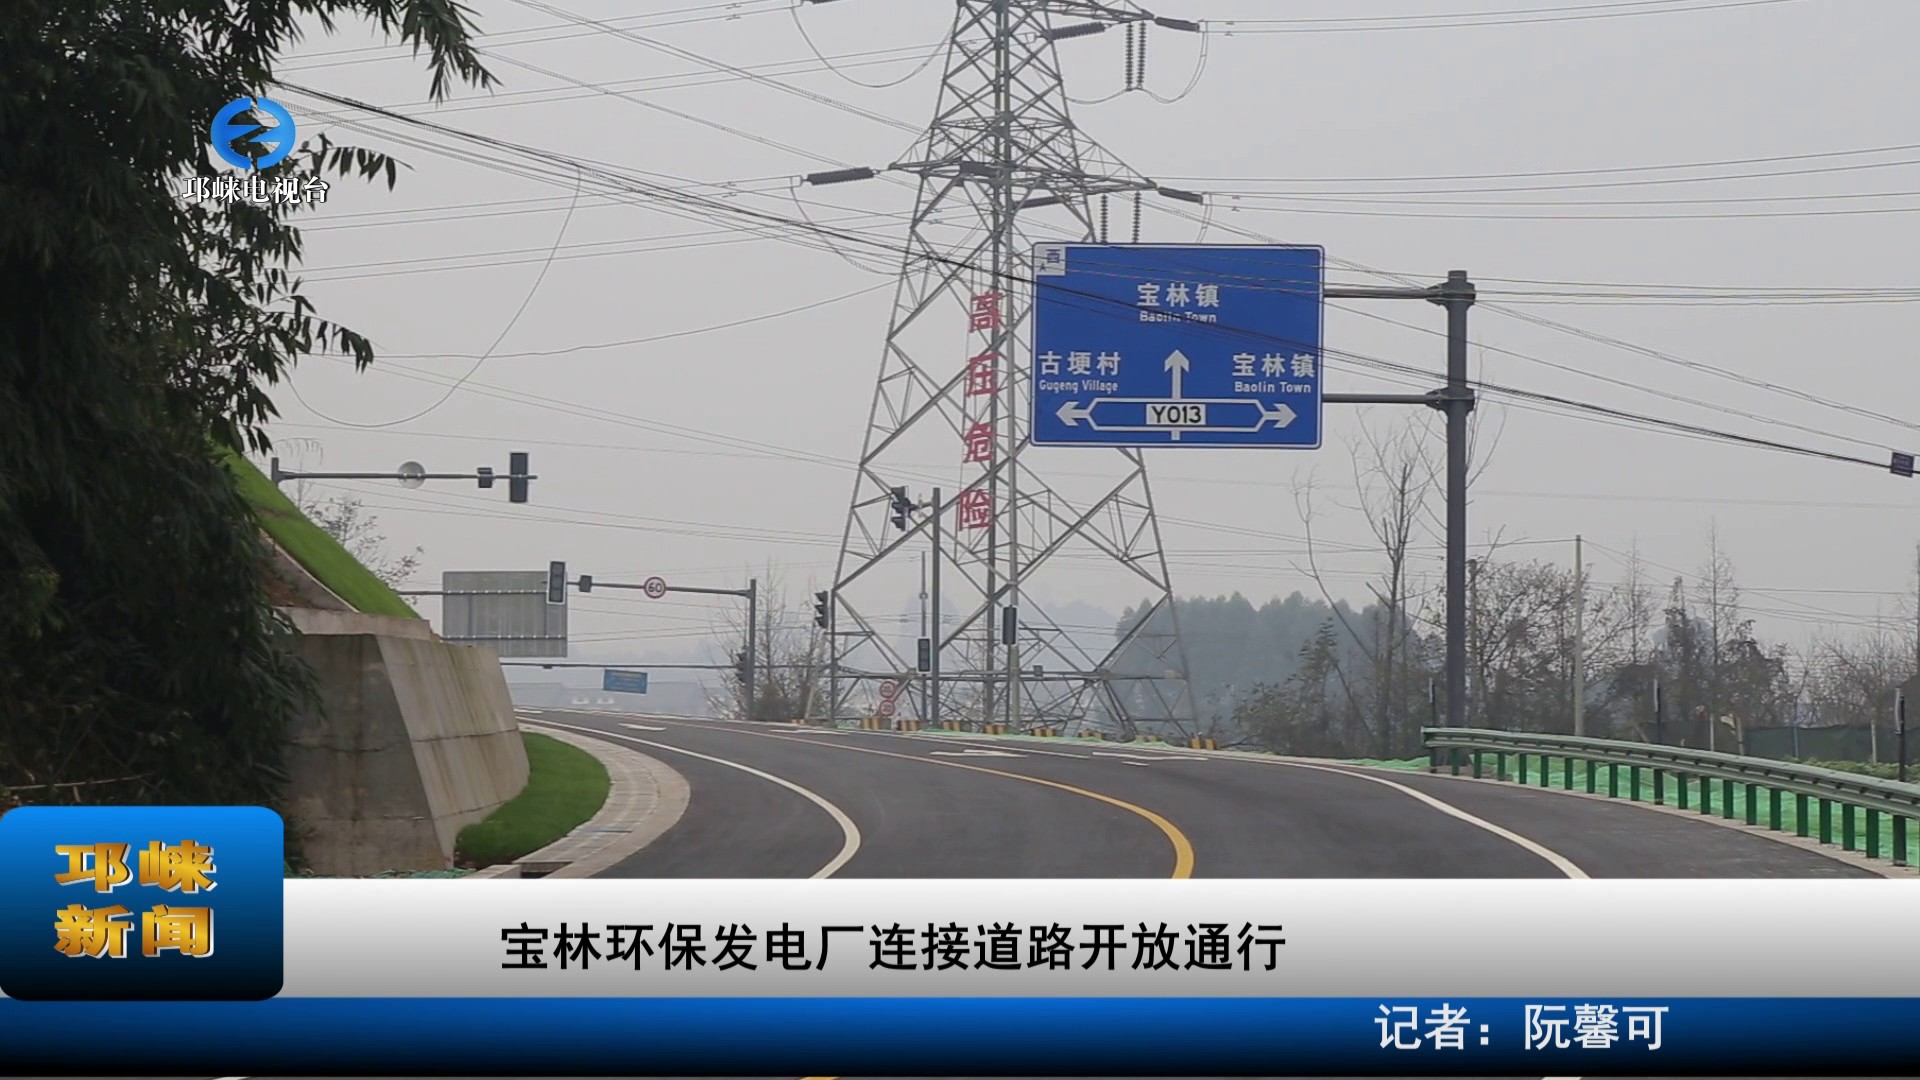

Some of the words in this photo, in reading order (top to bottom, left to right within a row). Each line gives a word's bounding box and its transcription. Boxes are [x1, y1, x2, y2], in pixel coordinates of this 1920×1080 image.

[1046, 249, 1060, 263] 西
[1136, 283, 1220, 308] 宝林镇
[1140, 310, 1181, 322] Baolin
[1184, 311, 1216, 323] Town
[1038, 350, 1121, 376] 古埂村
[1232, 352, 1316, 378] 宝林镇
[1039, 379, 1078, 394] Gugeng
[1082, 379, 1118, 394] Village
[1234, 381, 1275, 392] Baolin
[1279, 381, 1311, 393] Town
[959, 290, 1003, 531] 高压危险
[1150, 405, 1201, 424] Y013
[648, 582, 662, 593] 60
